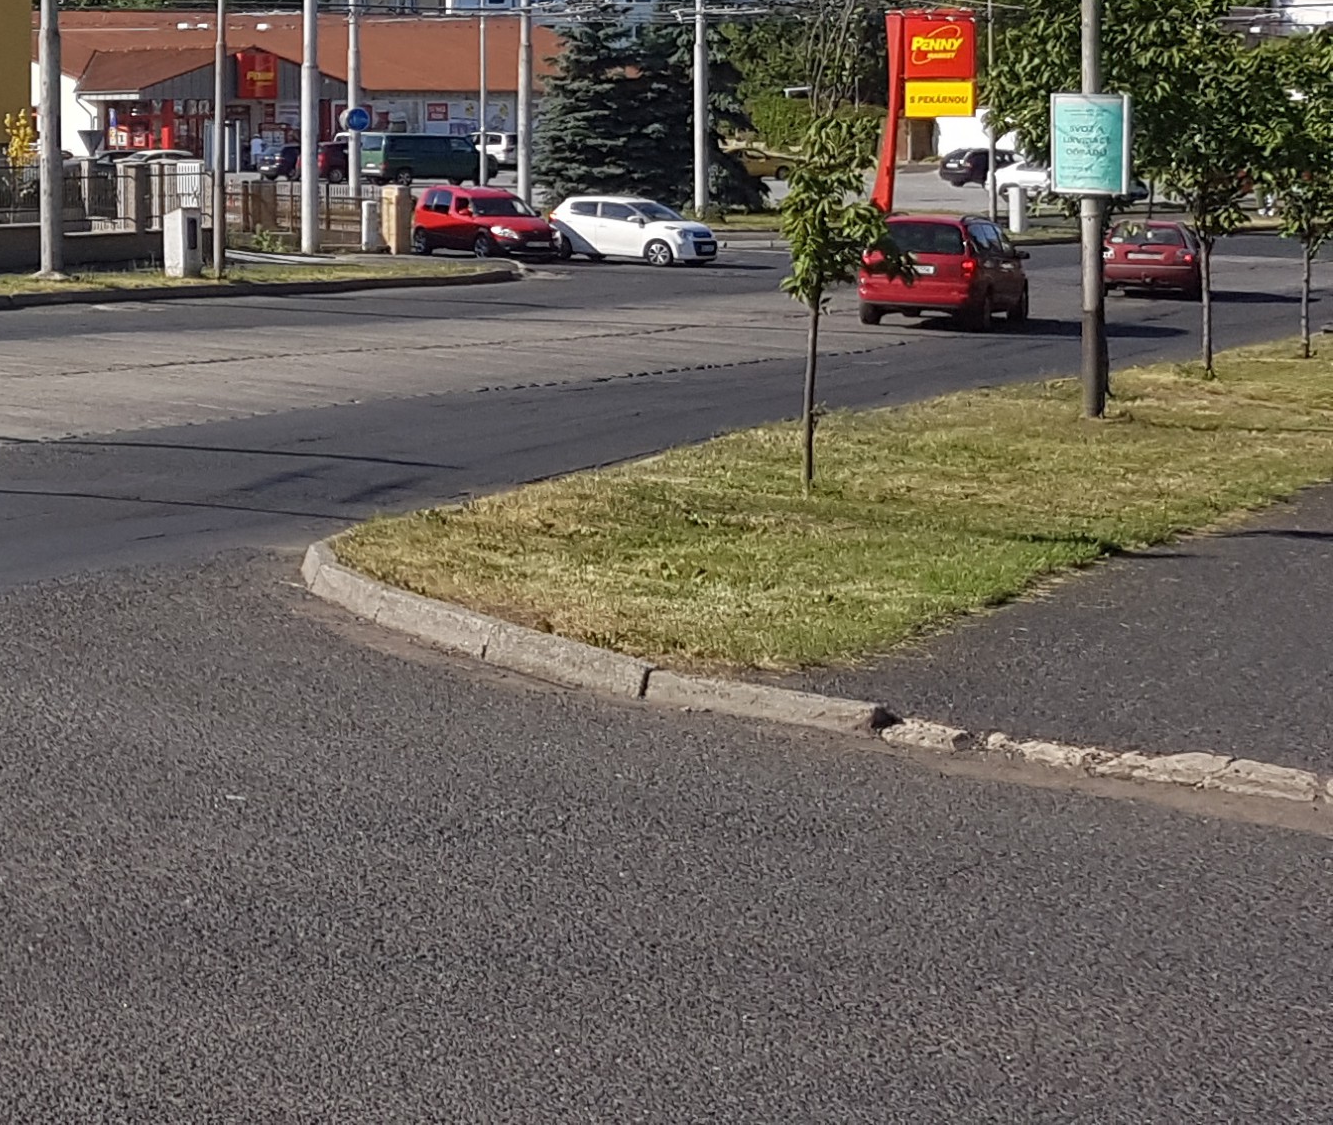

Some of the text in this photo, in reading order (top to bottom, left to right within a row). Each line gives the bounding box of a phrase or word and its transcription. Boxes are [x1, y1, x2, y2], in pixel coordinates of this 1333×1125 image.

[911, 36, 964, 51] PENNY
[909, 94, 969, 104] S PEKÁRNOU
